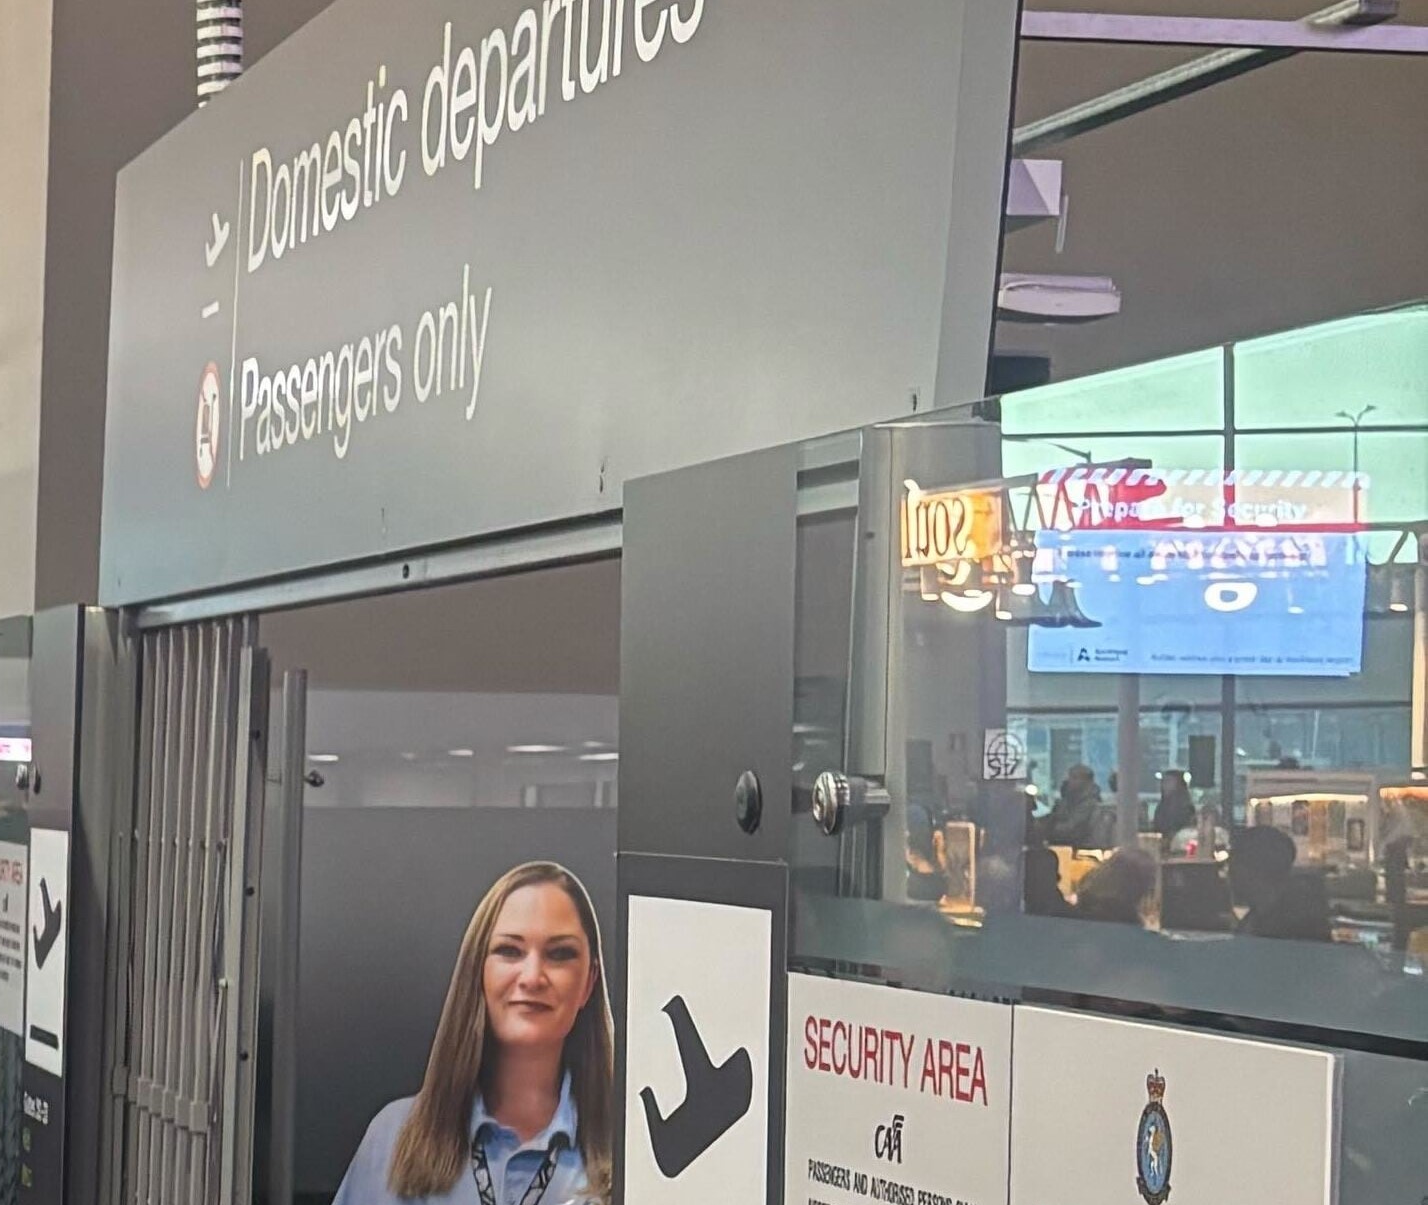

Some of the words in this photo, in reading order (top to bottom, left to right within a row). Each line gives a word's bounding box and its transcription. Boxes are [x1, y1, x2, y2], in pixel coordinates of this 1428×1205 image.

[247, 65, 408, 273] Domestic
[239, 324, 403, 461] Passengers
[414, 263, 493, 421] only
[804, 1015, 915, 1089] SECURITY
[919, 1038, 989, 1107] AREA
[808, 1159, 851, 1191] PASSENGERS
[853, 1172, 868, 1196] AND
